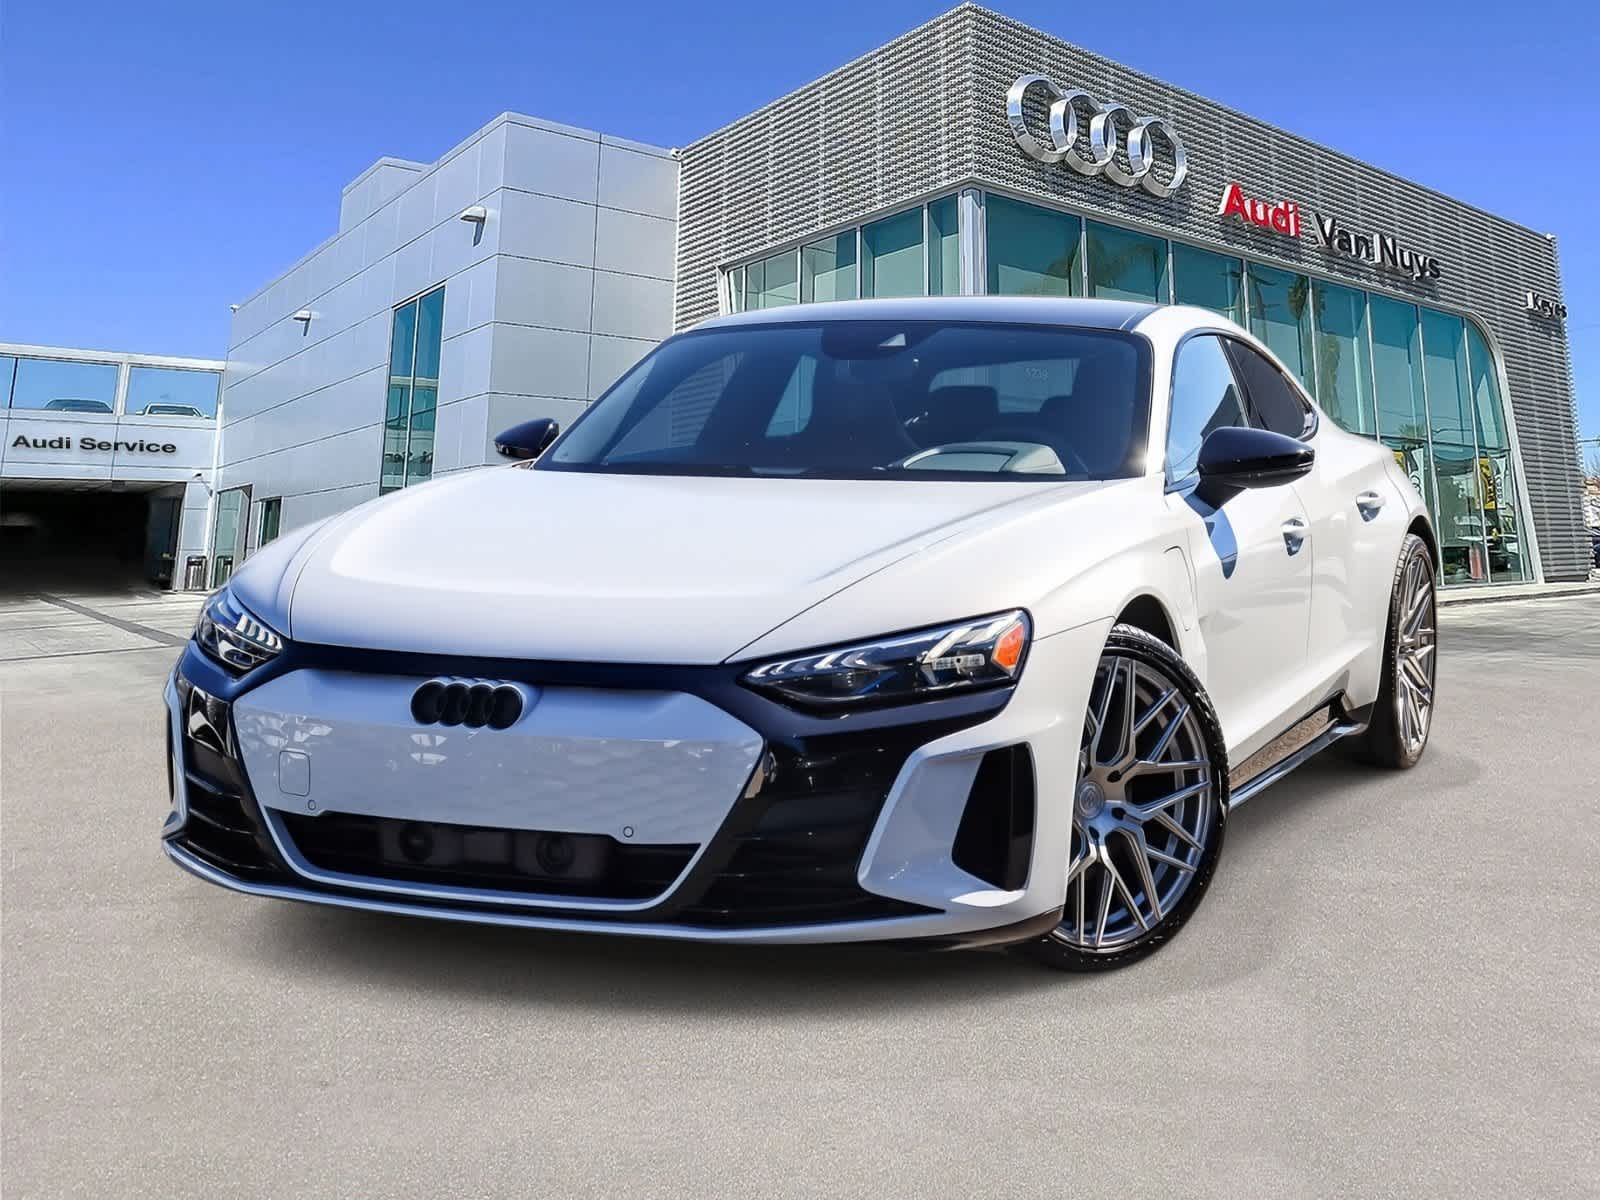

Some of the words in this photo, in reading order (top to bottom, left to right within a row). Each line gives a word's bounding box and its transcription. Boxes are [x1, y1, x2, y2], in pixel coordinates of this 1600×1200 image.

[1219, 182, 1302, 238] Audi
[1312, 210, 1370, 259] Van
[1374, 233, 1441, 280] Nuys
[12, 435, 71, 450] Audi
[79, 437, 177, 454] Service
